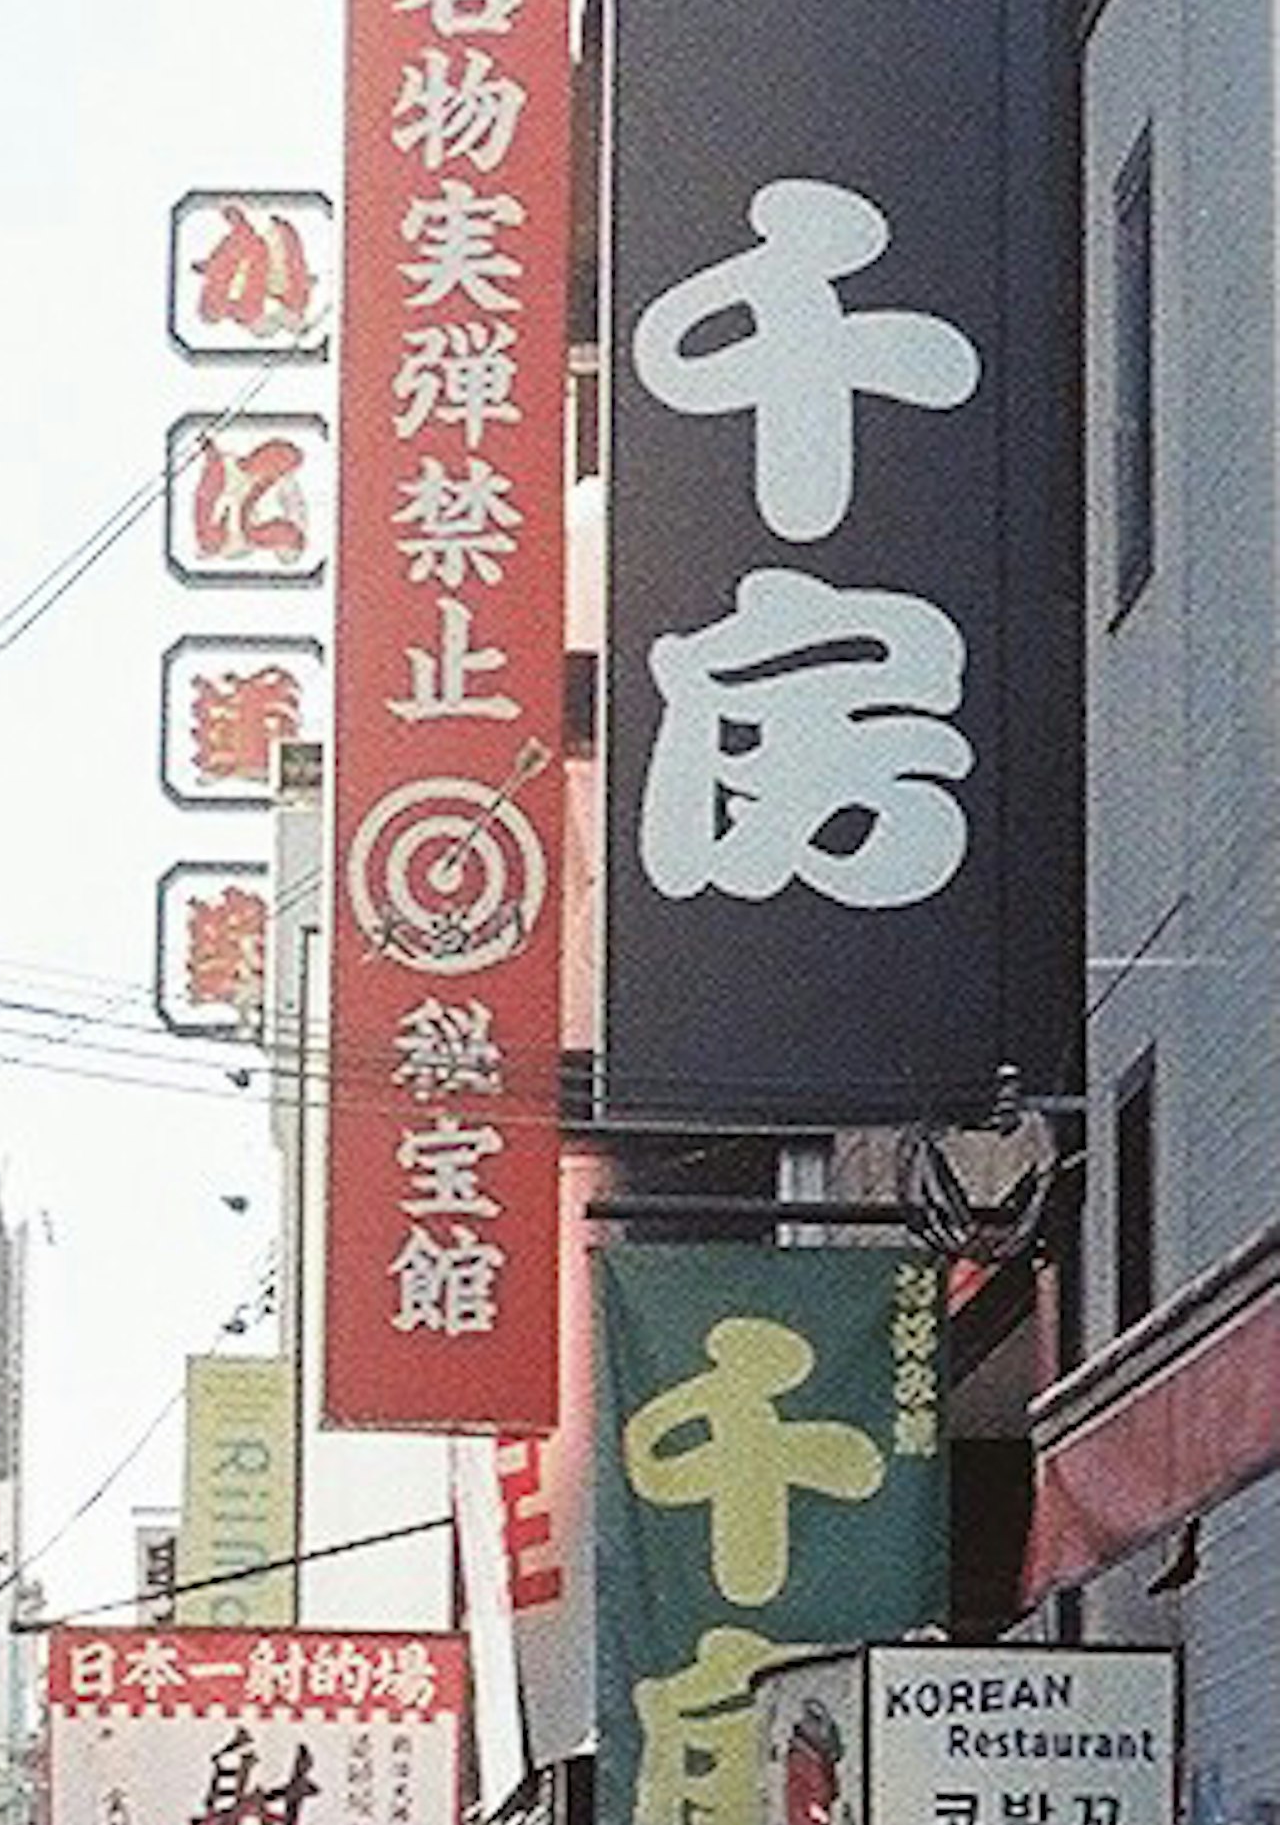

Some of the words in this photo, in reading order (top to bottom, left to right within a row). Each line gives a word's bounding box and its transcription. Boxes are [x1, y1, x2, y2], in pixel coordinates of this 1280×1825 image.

[634, 176, 982, 910] 千房
[68, 1638, 438, 1710] 日本一射的場
[886, 1674, 1074, 1718] KOREAN
[948, 1724, 1157, 1766] Restaurant
